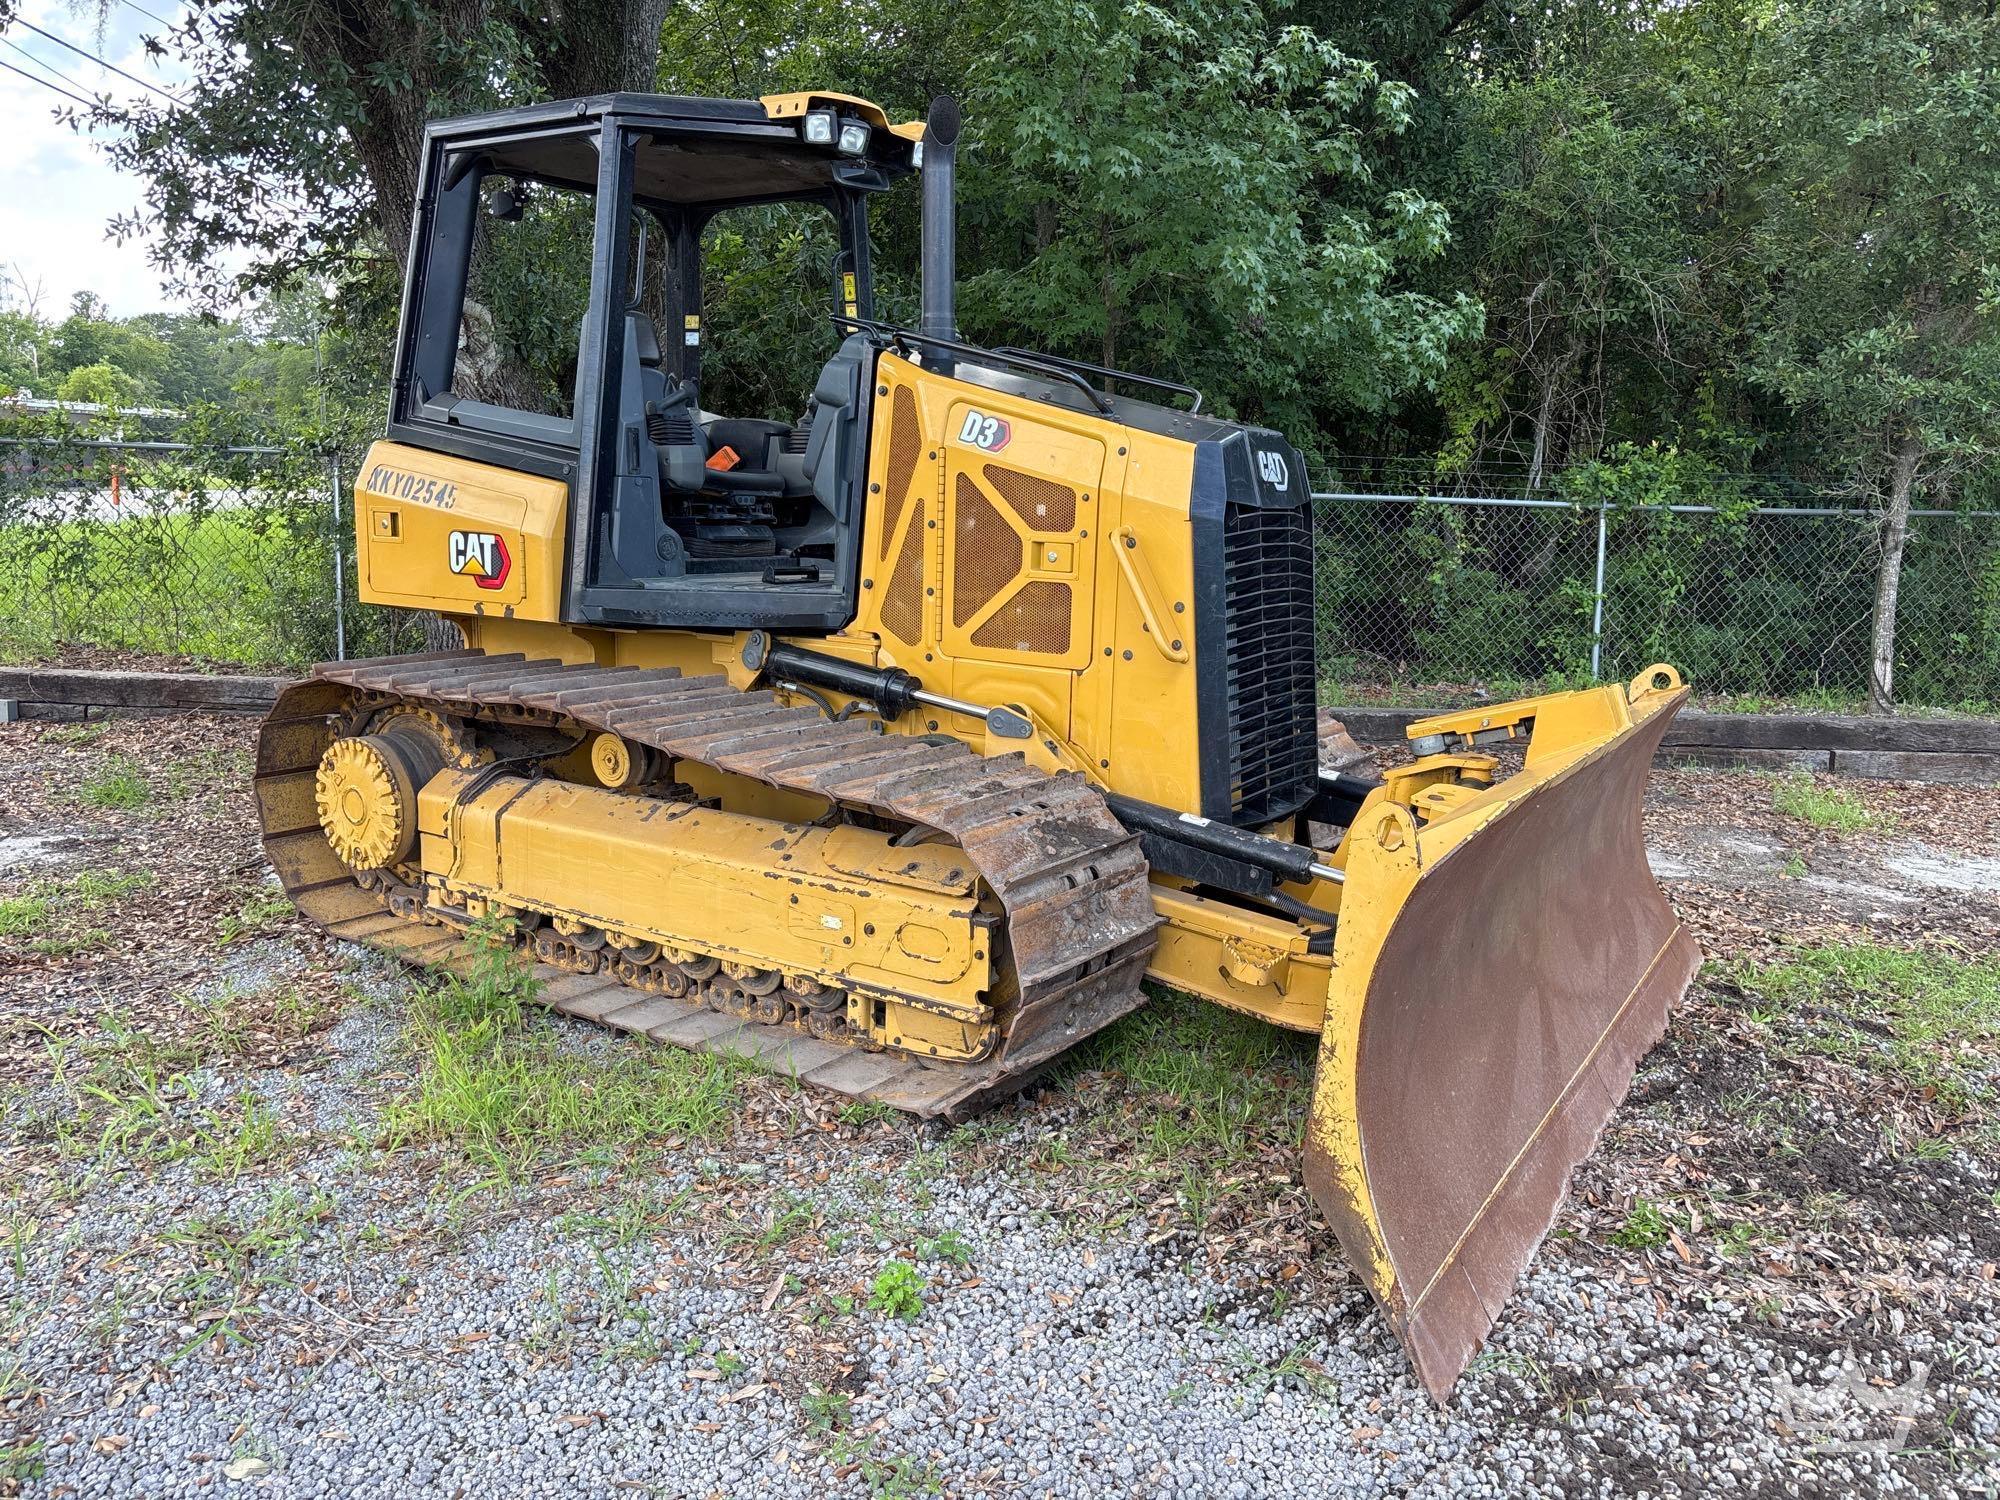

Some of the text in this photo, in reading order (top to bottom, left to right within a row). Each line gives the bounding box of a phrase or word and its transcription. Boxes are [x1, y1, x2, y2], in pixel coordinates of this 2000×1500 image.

[960, 411, 998, 448] D3
[1258, 450, 1282, 482] CAT
[368, 468, 458, 509] XKY02545
[449, 532, 496, 576] CAT
